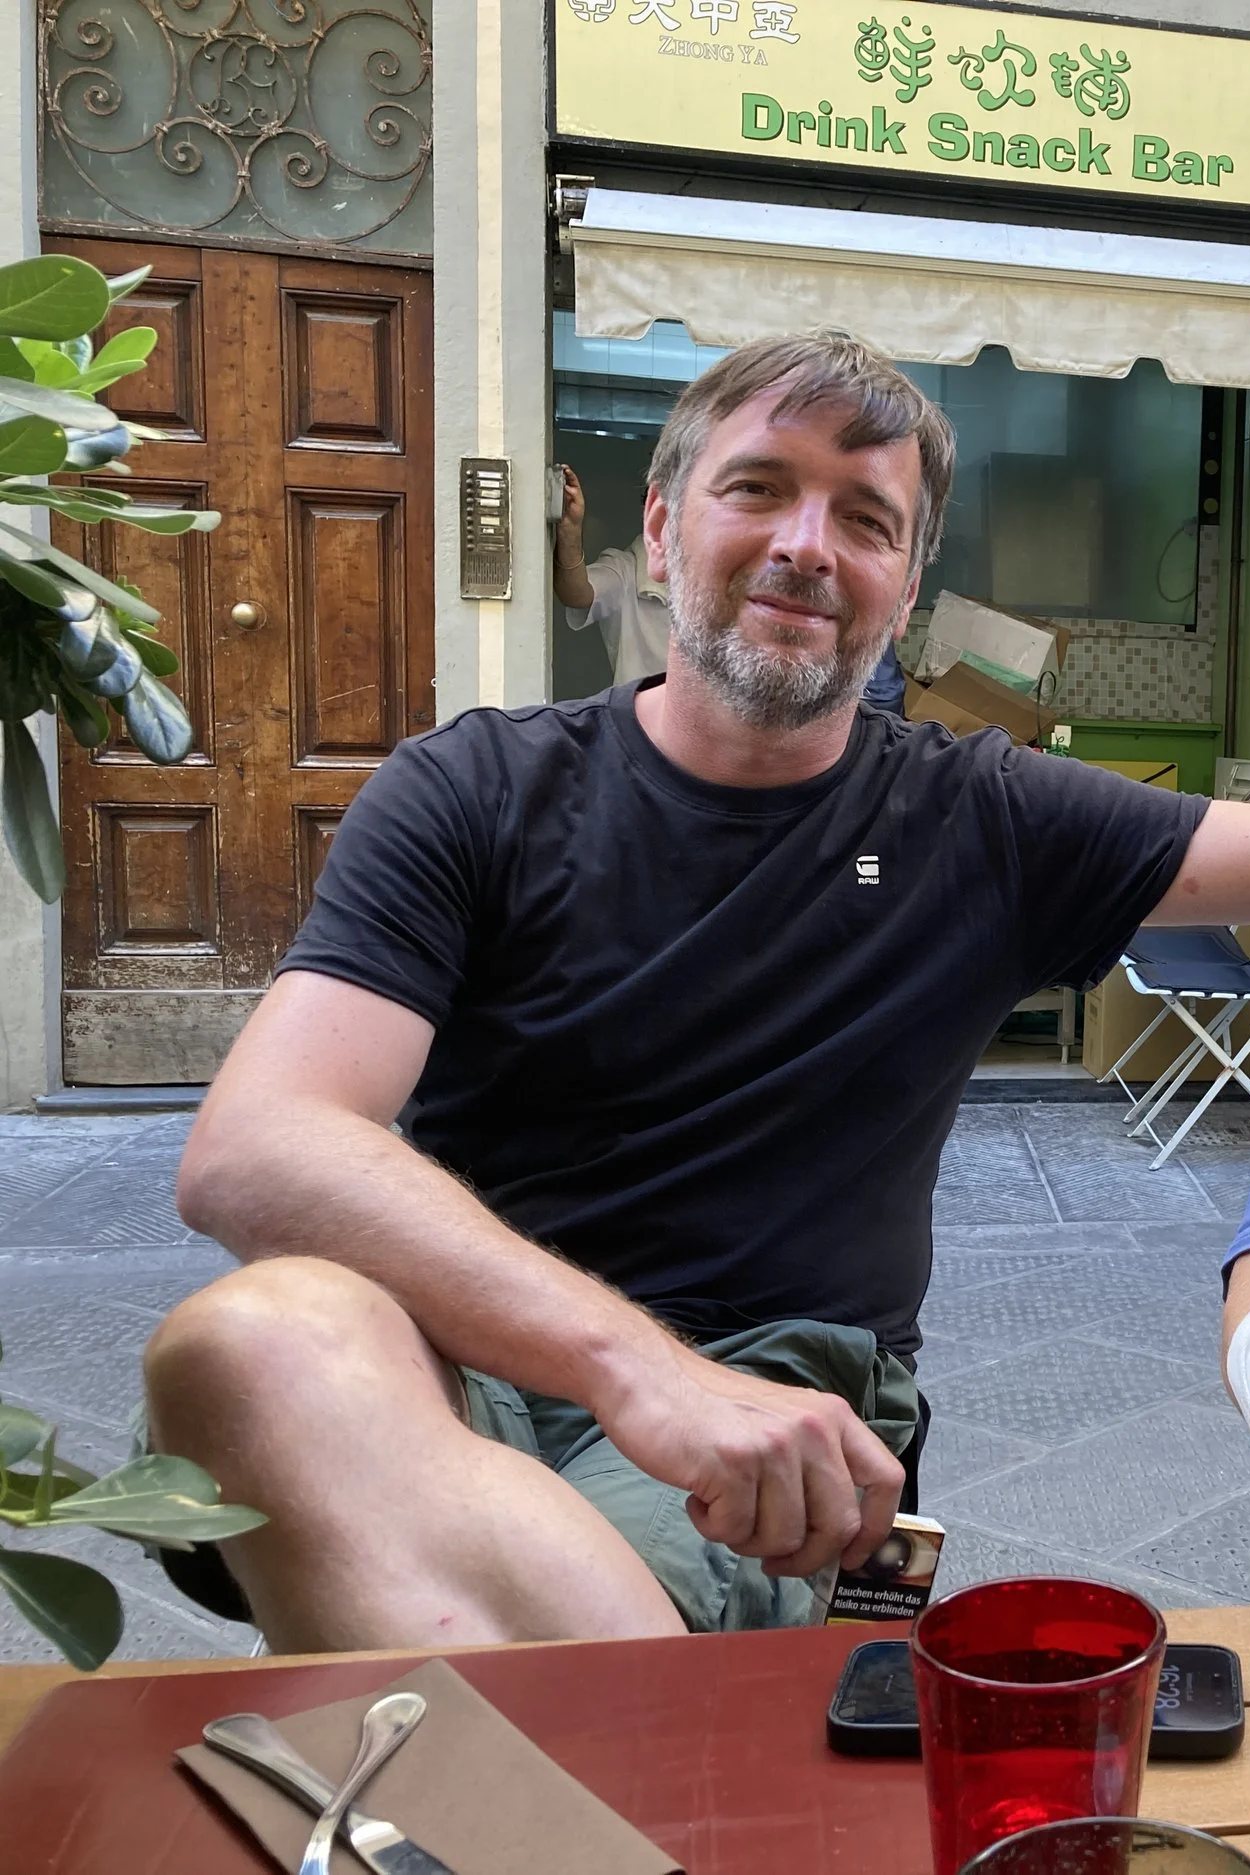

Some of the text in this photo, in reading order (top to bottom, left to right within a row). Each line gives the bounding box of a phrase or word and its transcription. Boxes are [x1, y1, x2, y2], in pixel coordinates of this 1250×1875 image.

[658, 35, 769, 66] ZHONG YA
[740, 93, 1235, 187] Drink Snack Bar
[858, 877, 879, 885] RAW
[834, 1599, 914, 1617] Risiko zu erblinden
[838, 1587, 921, 1605] Rauchen erhöht das
[1155, 1664, 1180, 1709] 16:28
